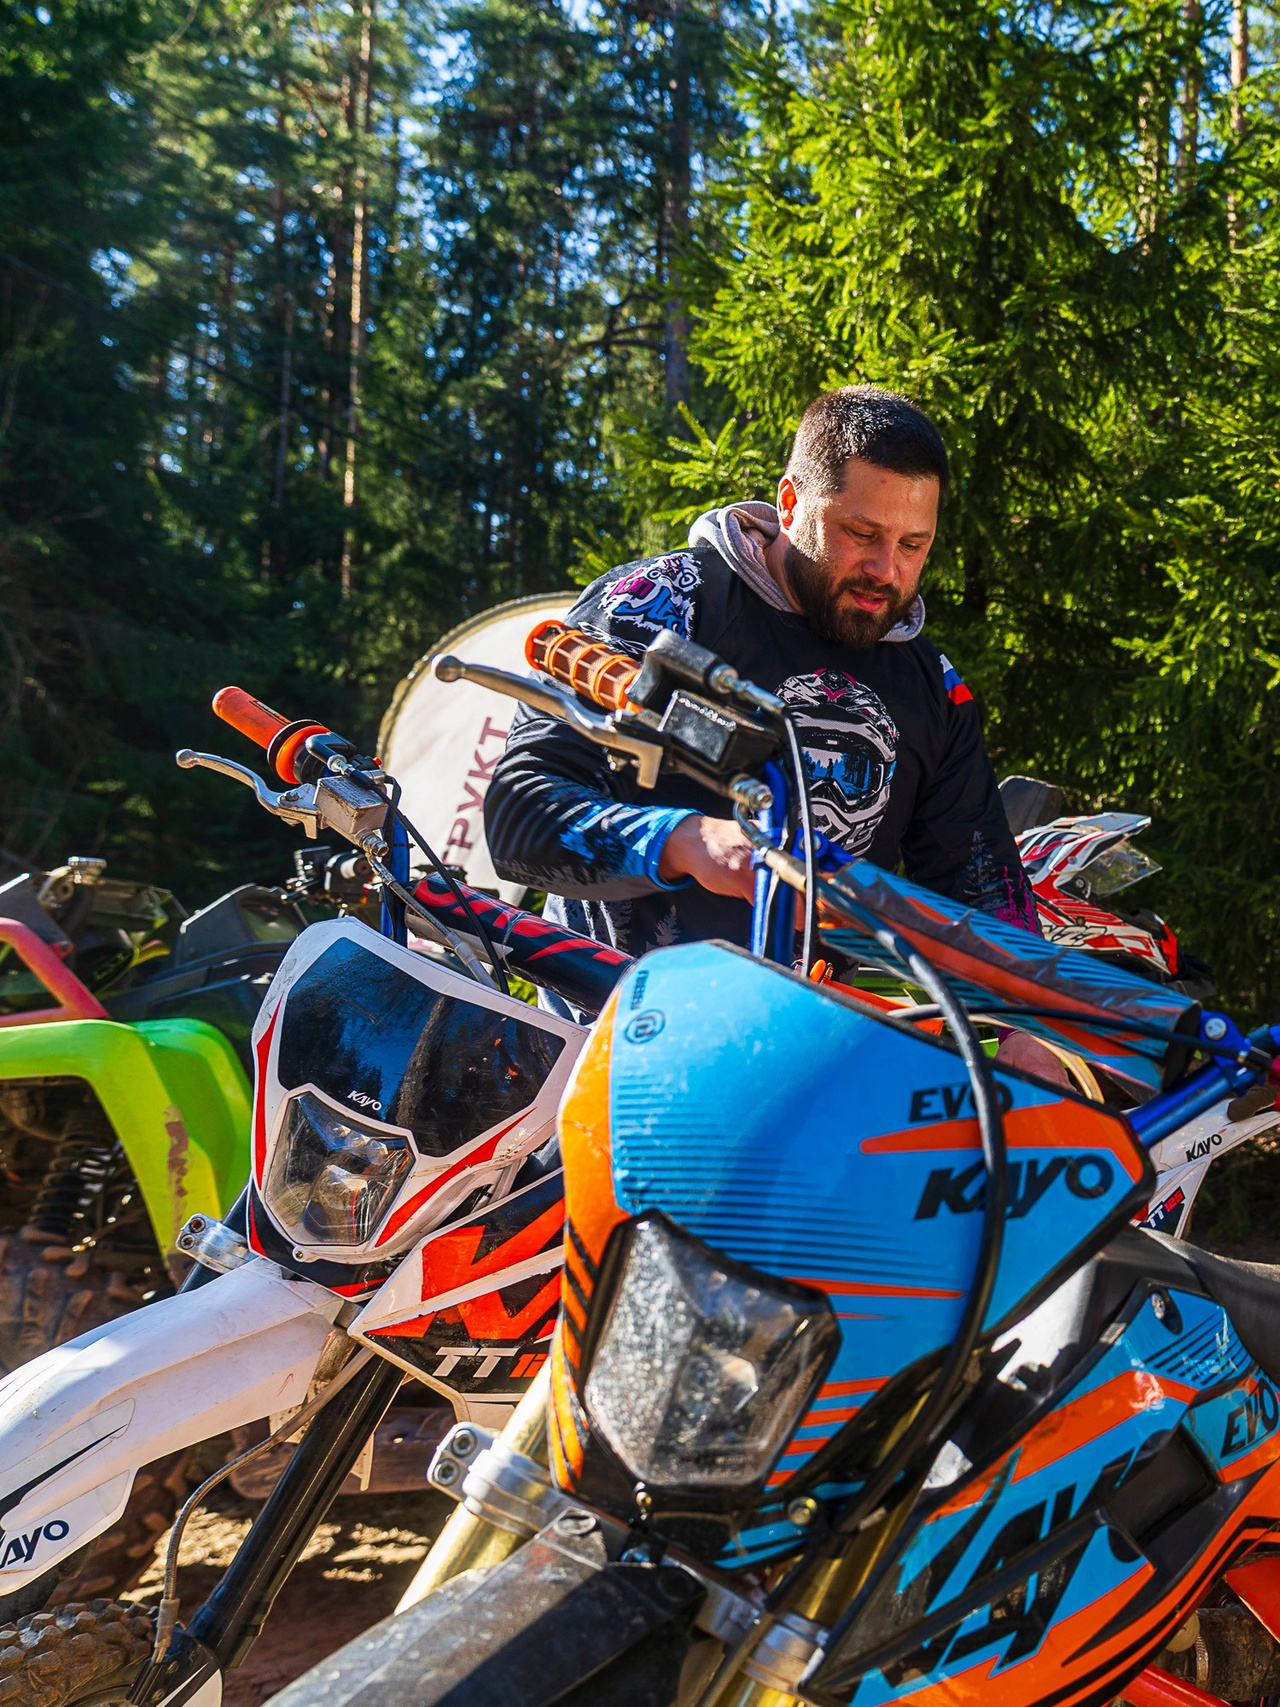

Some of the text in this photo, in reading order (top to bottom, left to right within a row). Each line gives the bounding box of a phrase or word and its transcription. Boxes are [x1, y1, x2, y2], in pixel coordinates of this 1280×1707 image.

[347, 1090, 382, 1111] KAYO
[909, 1078, 1013, 1123] EVO
[1186, 1133, 1222, 1162] KAYO
